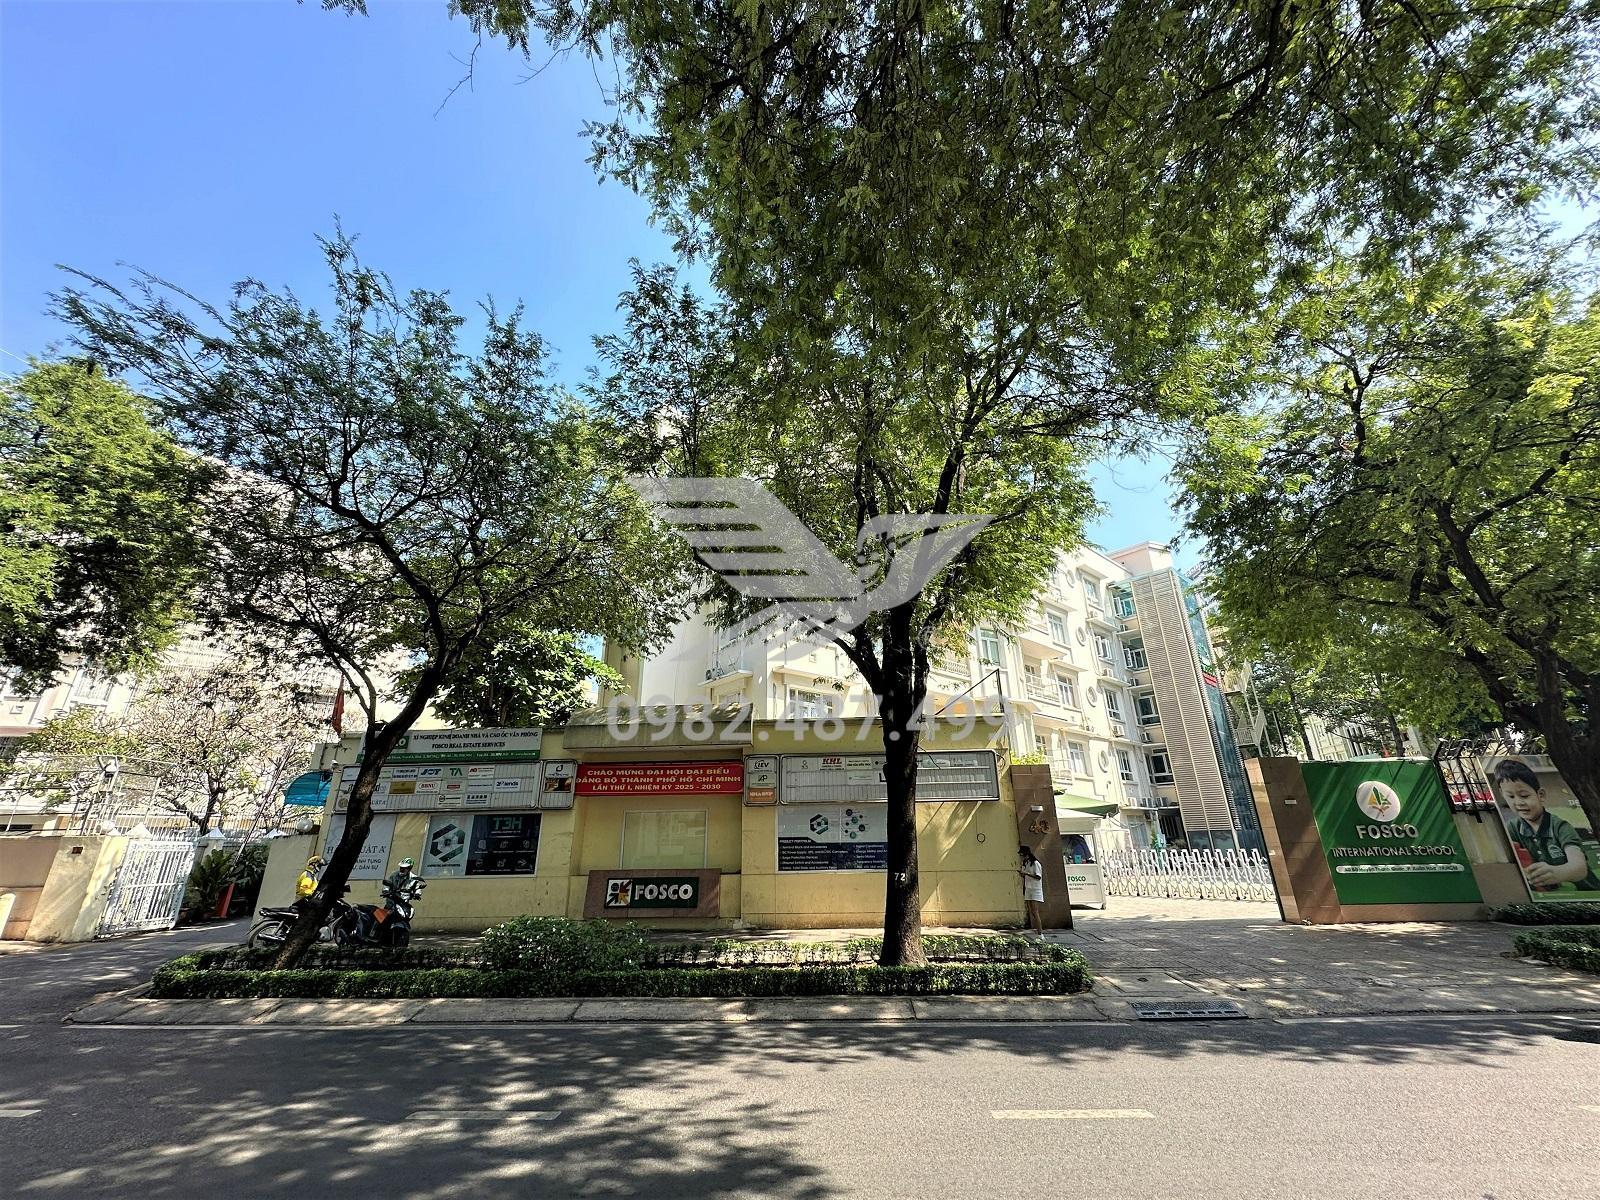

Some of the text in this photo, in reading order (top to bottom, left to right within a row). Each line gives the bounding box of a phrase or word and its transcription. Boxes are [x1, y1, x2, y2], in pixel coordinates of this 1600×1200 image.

[604, 776, 617, 784] BỘ
[1356, 823, 1419, 839] FOSCO
[1333, 845, 1456, 857] INTERNATIONAL SCHOOL
[635, 884, 693, 900] FOSCO
